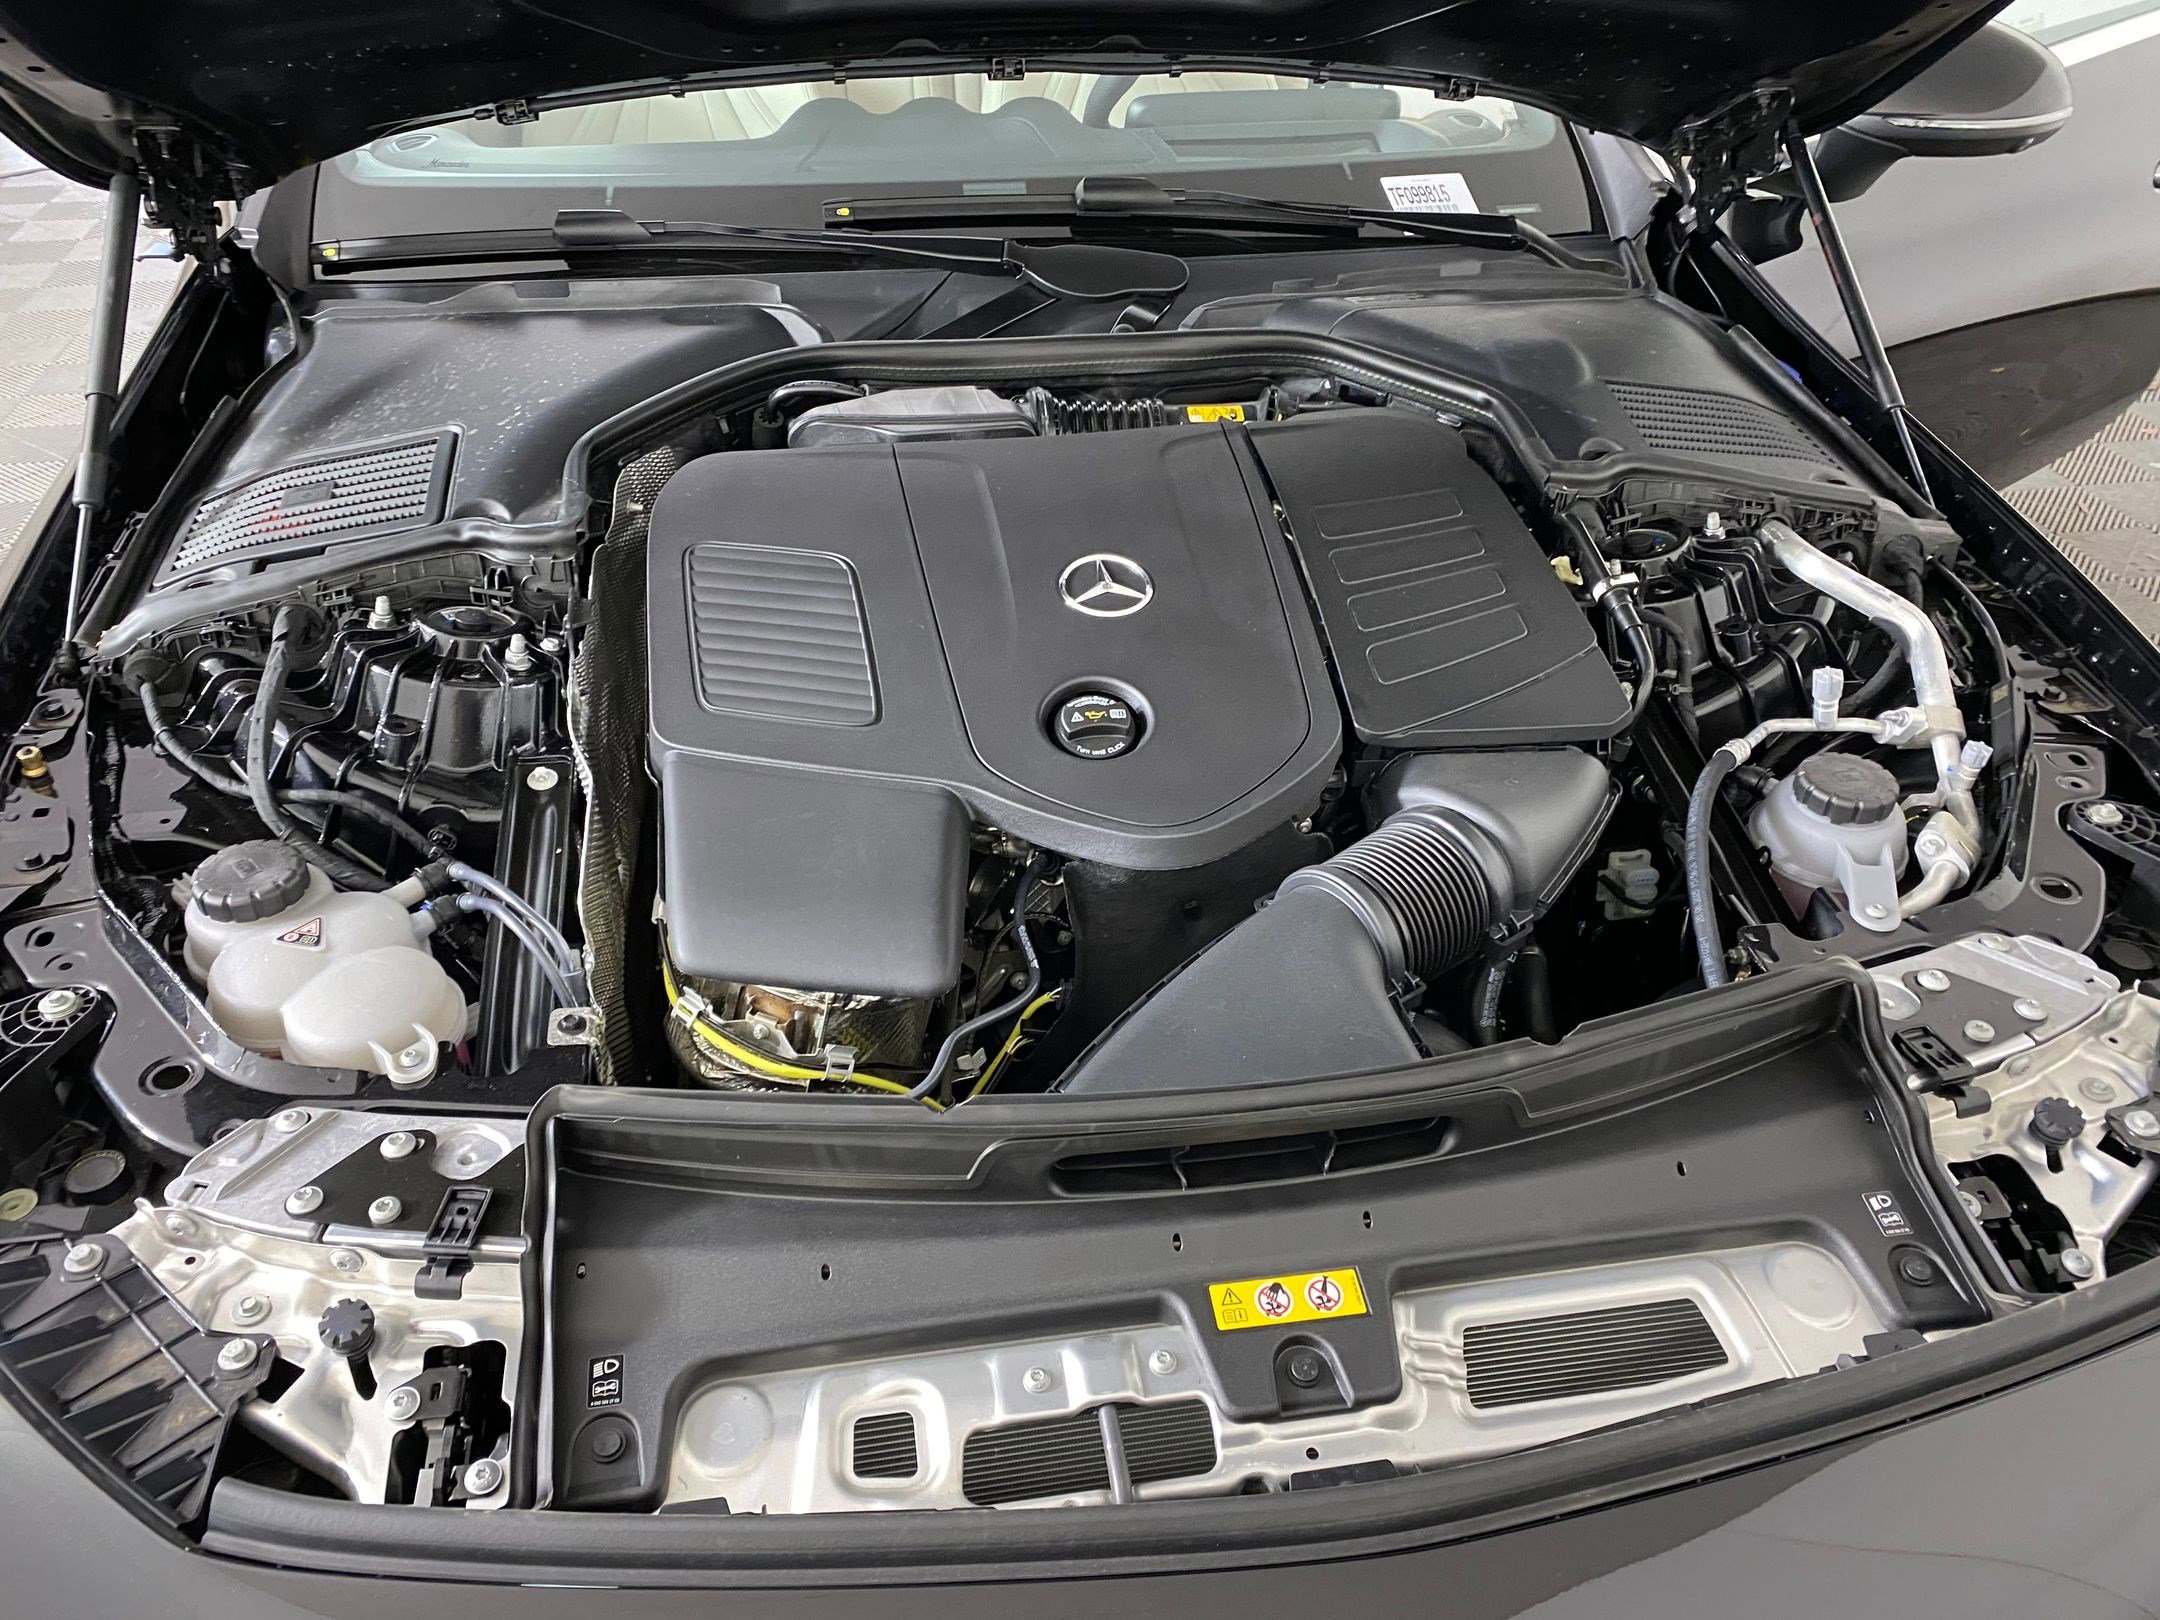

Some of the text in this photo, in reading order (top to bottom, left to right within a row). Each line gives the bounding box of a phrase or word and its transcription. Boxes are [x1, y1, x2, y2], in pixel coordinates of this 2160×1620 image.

[1388, 184, 1451, 206] TF099815
[1076, 744, 1091, 755] Turn
[1107, 741, 1126, 754] CLICK
